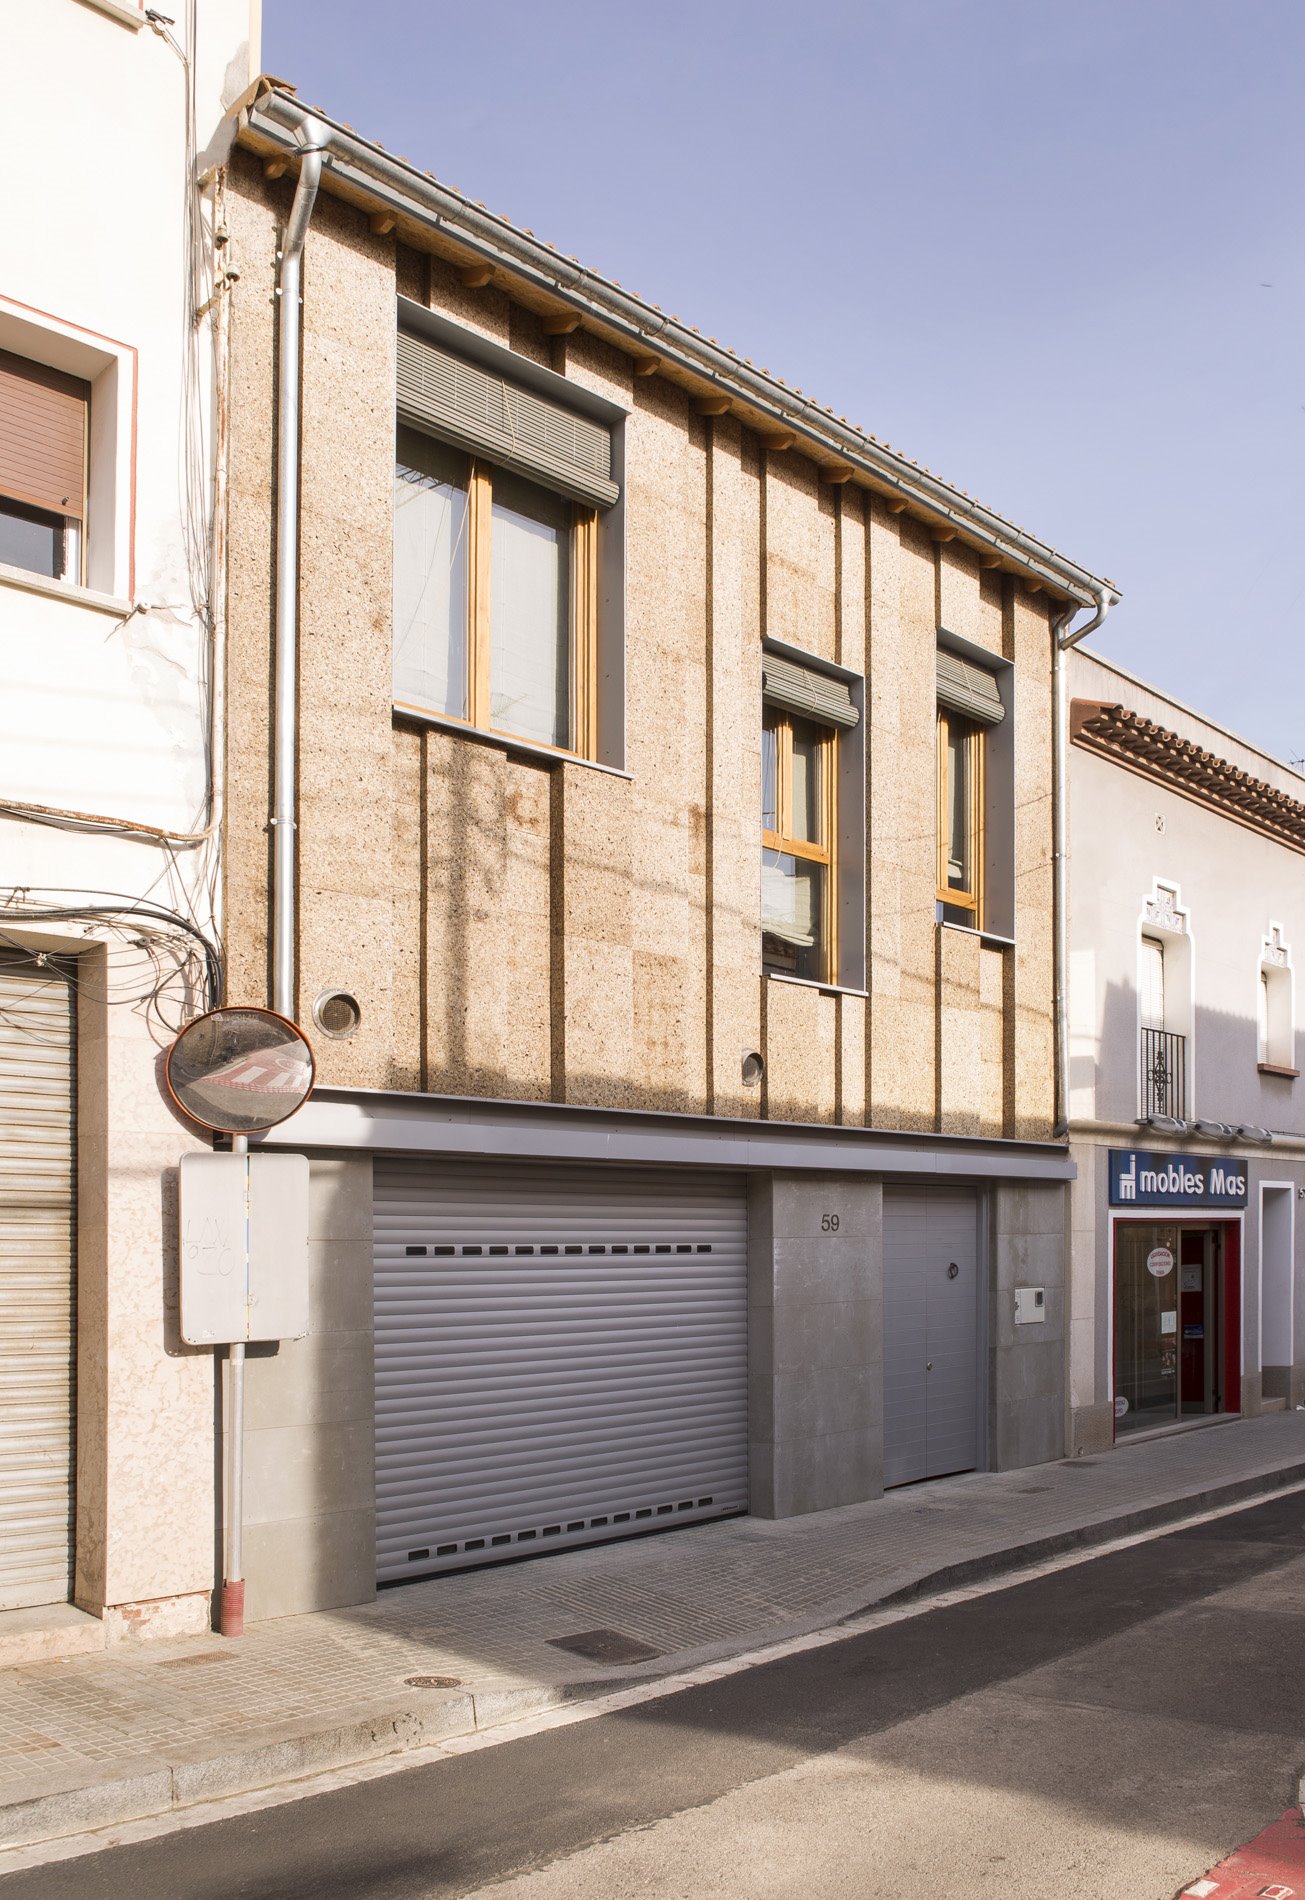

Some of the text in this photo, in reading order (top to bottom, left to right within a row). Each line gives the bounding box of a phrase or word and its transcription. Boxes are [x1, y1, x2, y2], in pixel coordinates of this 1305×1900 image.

[1139, 1164, 1246, 1196] mobles Mas
[821, 1214, 840, 1232] 59
